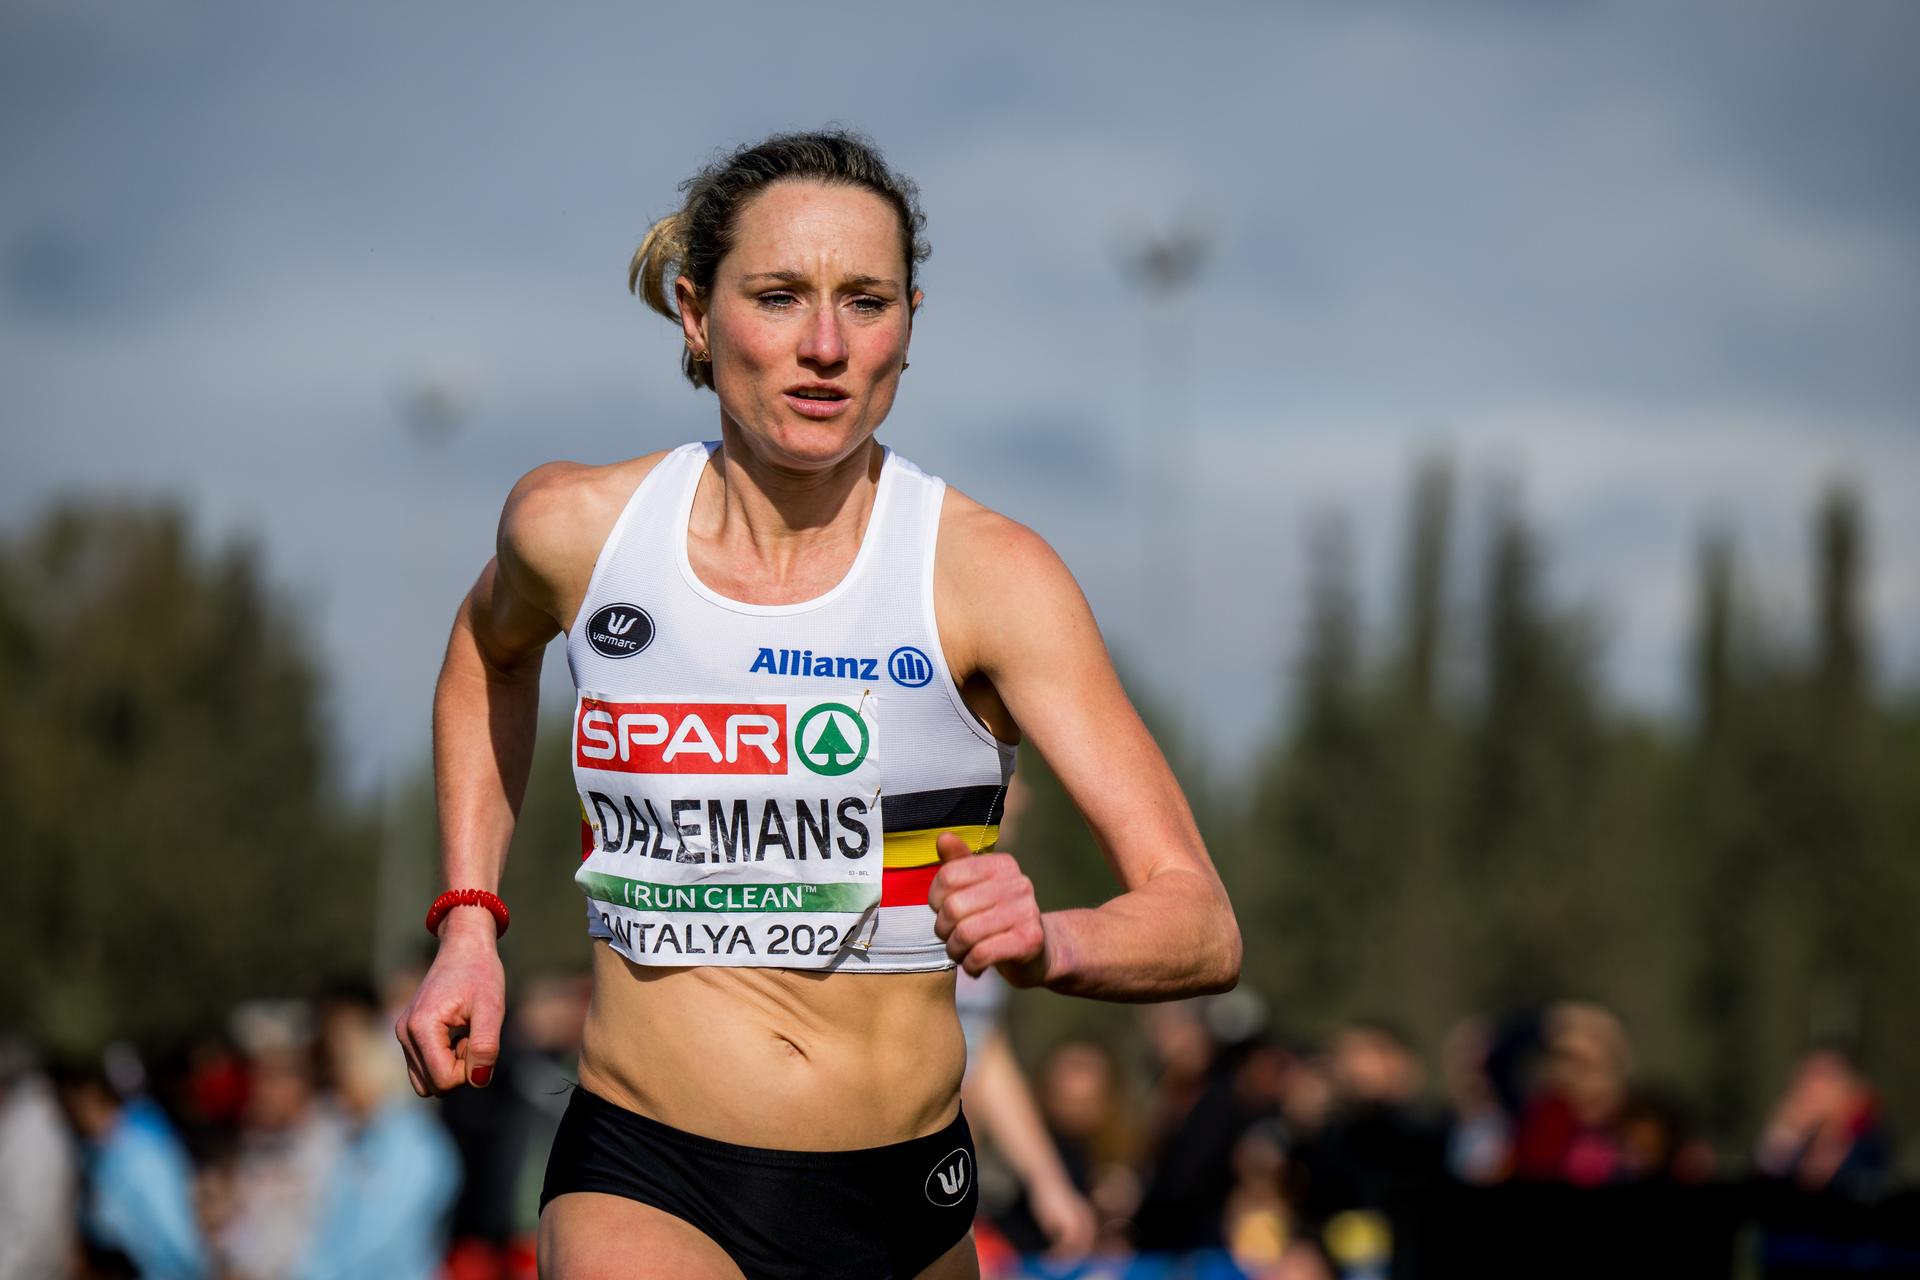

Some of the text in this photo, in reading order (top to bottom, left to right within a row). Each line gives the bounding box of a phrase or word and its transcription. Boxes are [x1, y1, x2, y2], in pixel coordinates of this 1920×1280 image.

[593, 631, 637, 650] vermarc
[749, 647, 879, 681] Allianz
[581, 711, 781, 764] SPAR
[588, 791, 870, 865] DALEMANS
[634, 884, 696, 909] RUN
